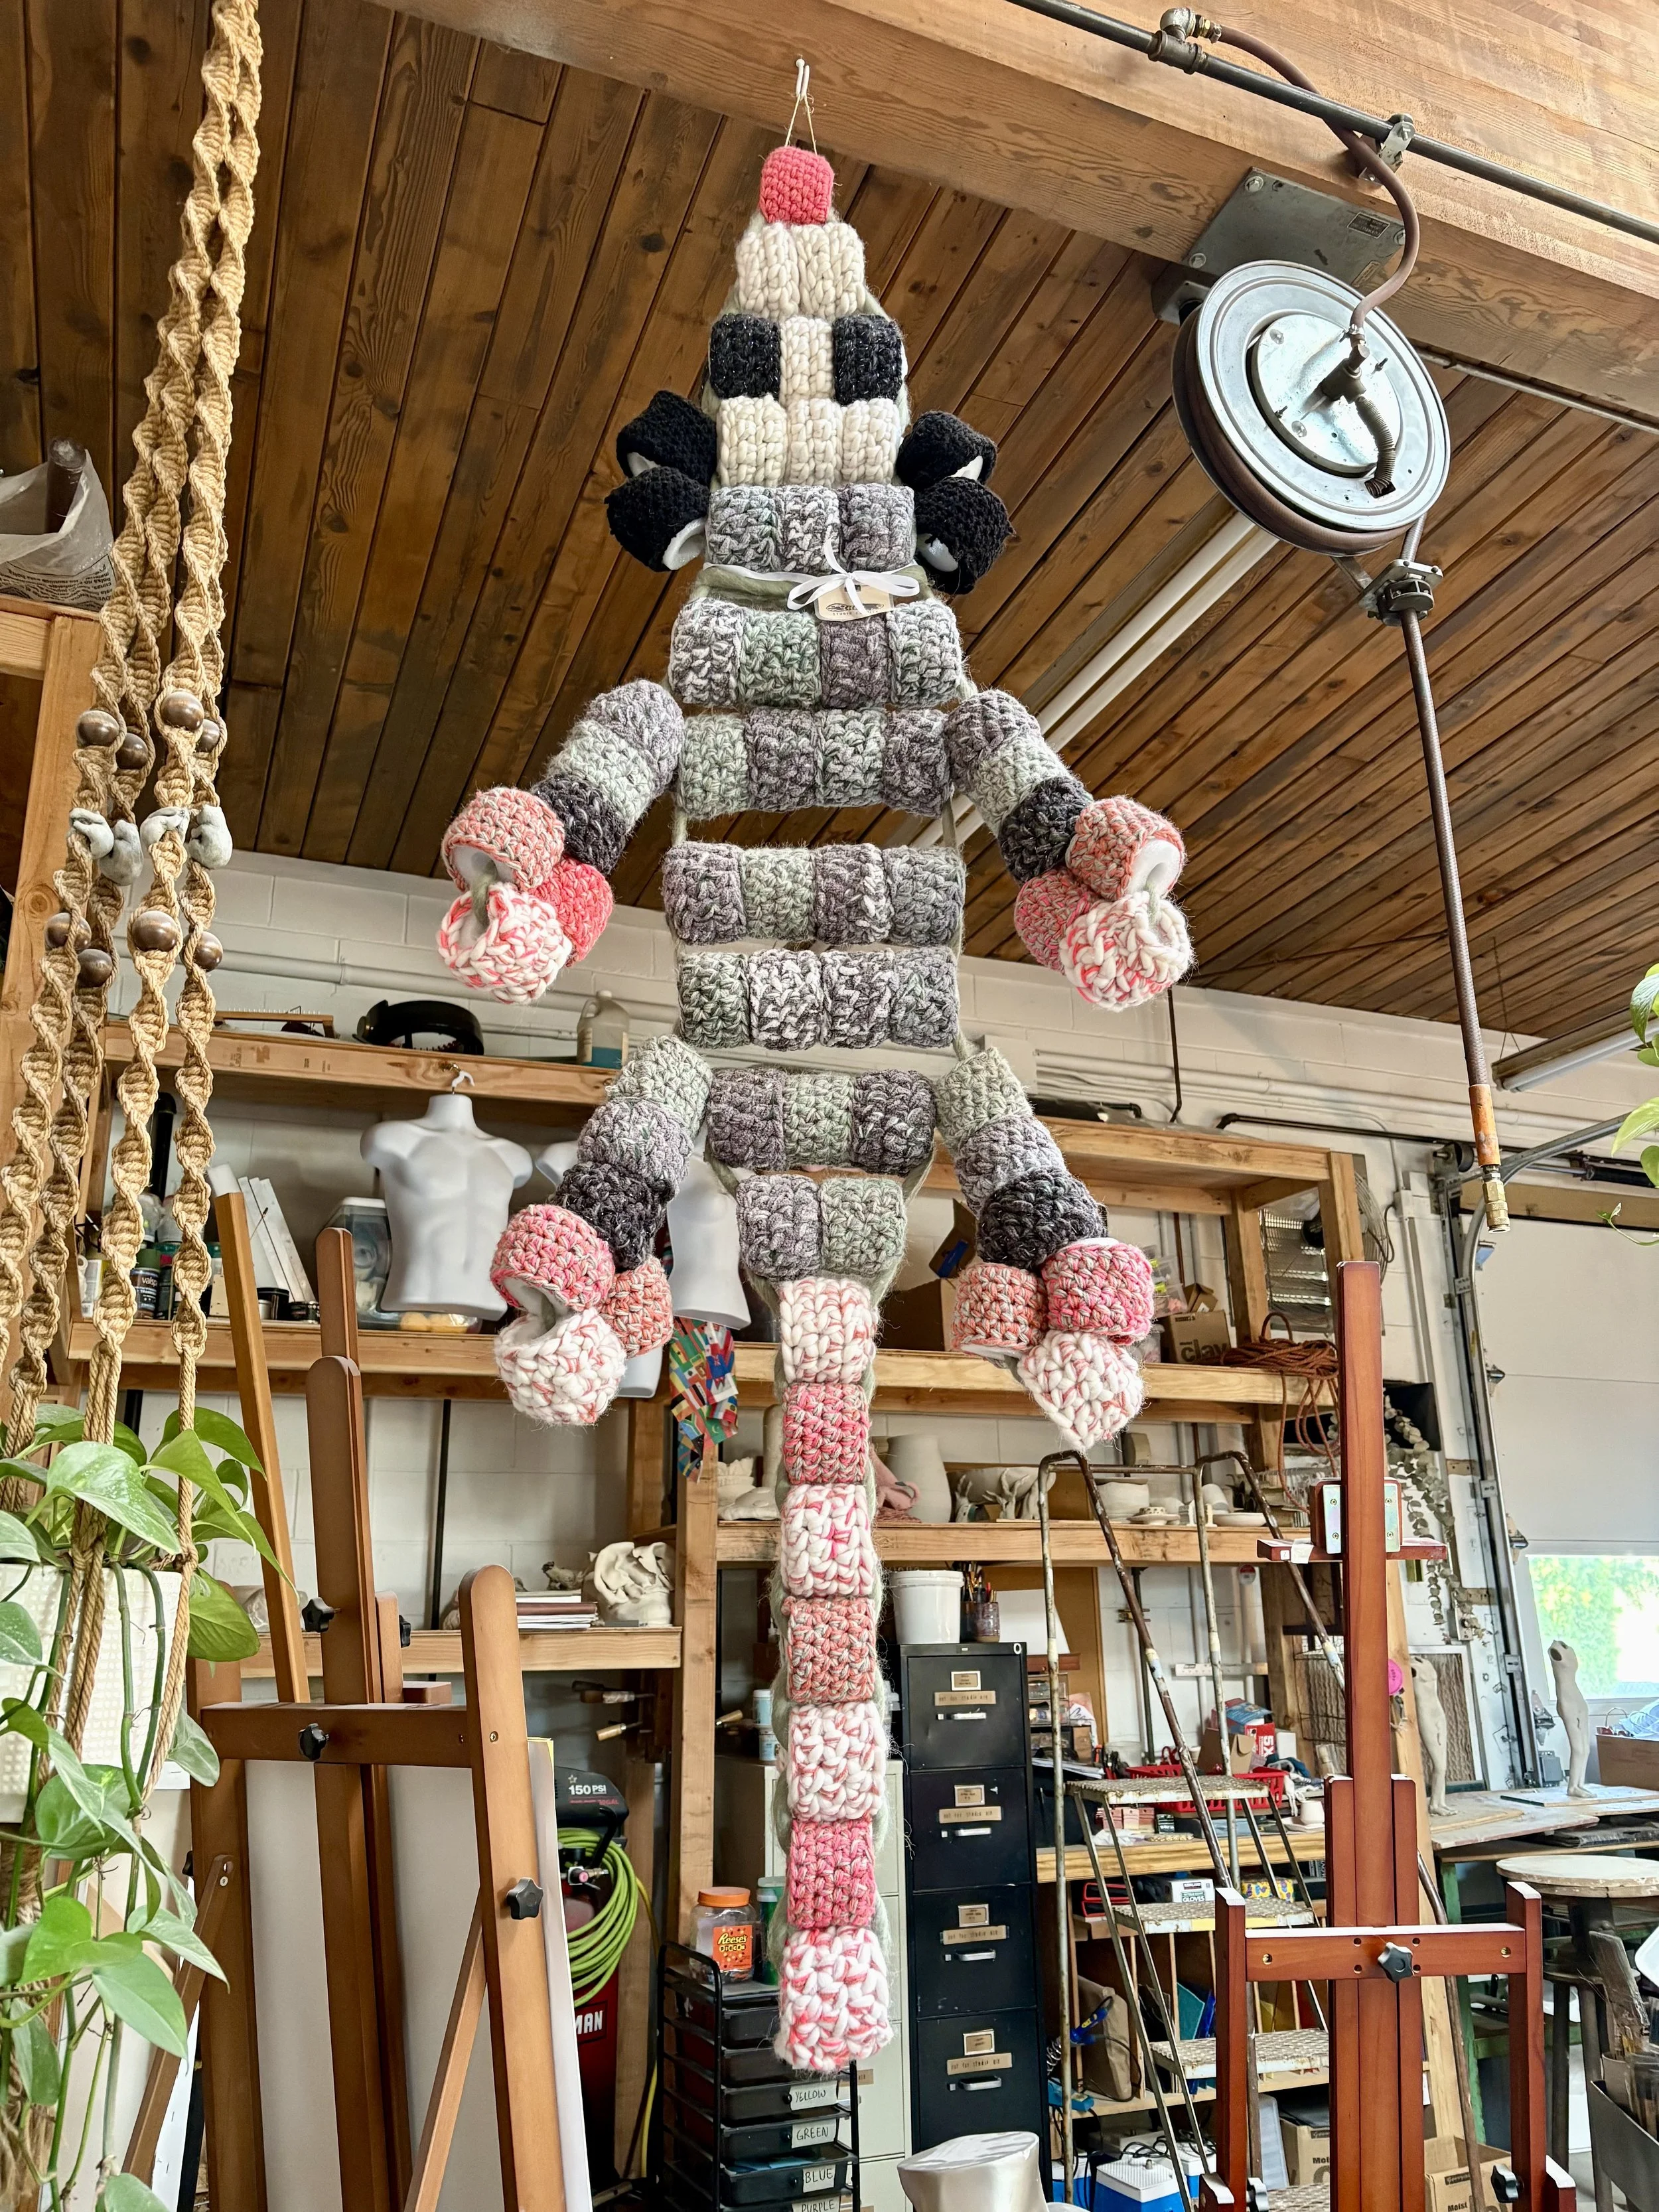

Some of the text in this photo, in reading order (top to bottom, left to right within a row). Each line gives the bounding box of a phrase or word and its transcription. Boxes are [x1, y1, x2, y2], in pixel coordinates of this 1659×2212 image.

[141, 1276, 158, 1287] valsp
[1181, 1339, 1228, 1362] clay
[568, 1784, 607, 1795] 150 PSI
[717, 1932, 748, 1945] Reese's
[795, 2089, 826, 2103] YELLOW
[796, 2126, 828, 2141] GREEN
[805, 2168, 833, 2183] BLUE
[801, 2199, 835, 2212] PURPLE
[1447, 2201, 1468, 2212] Moist
